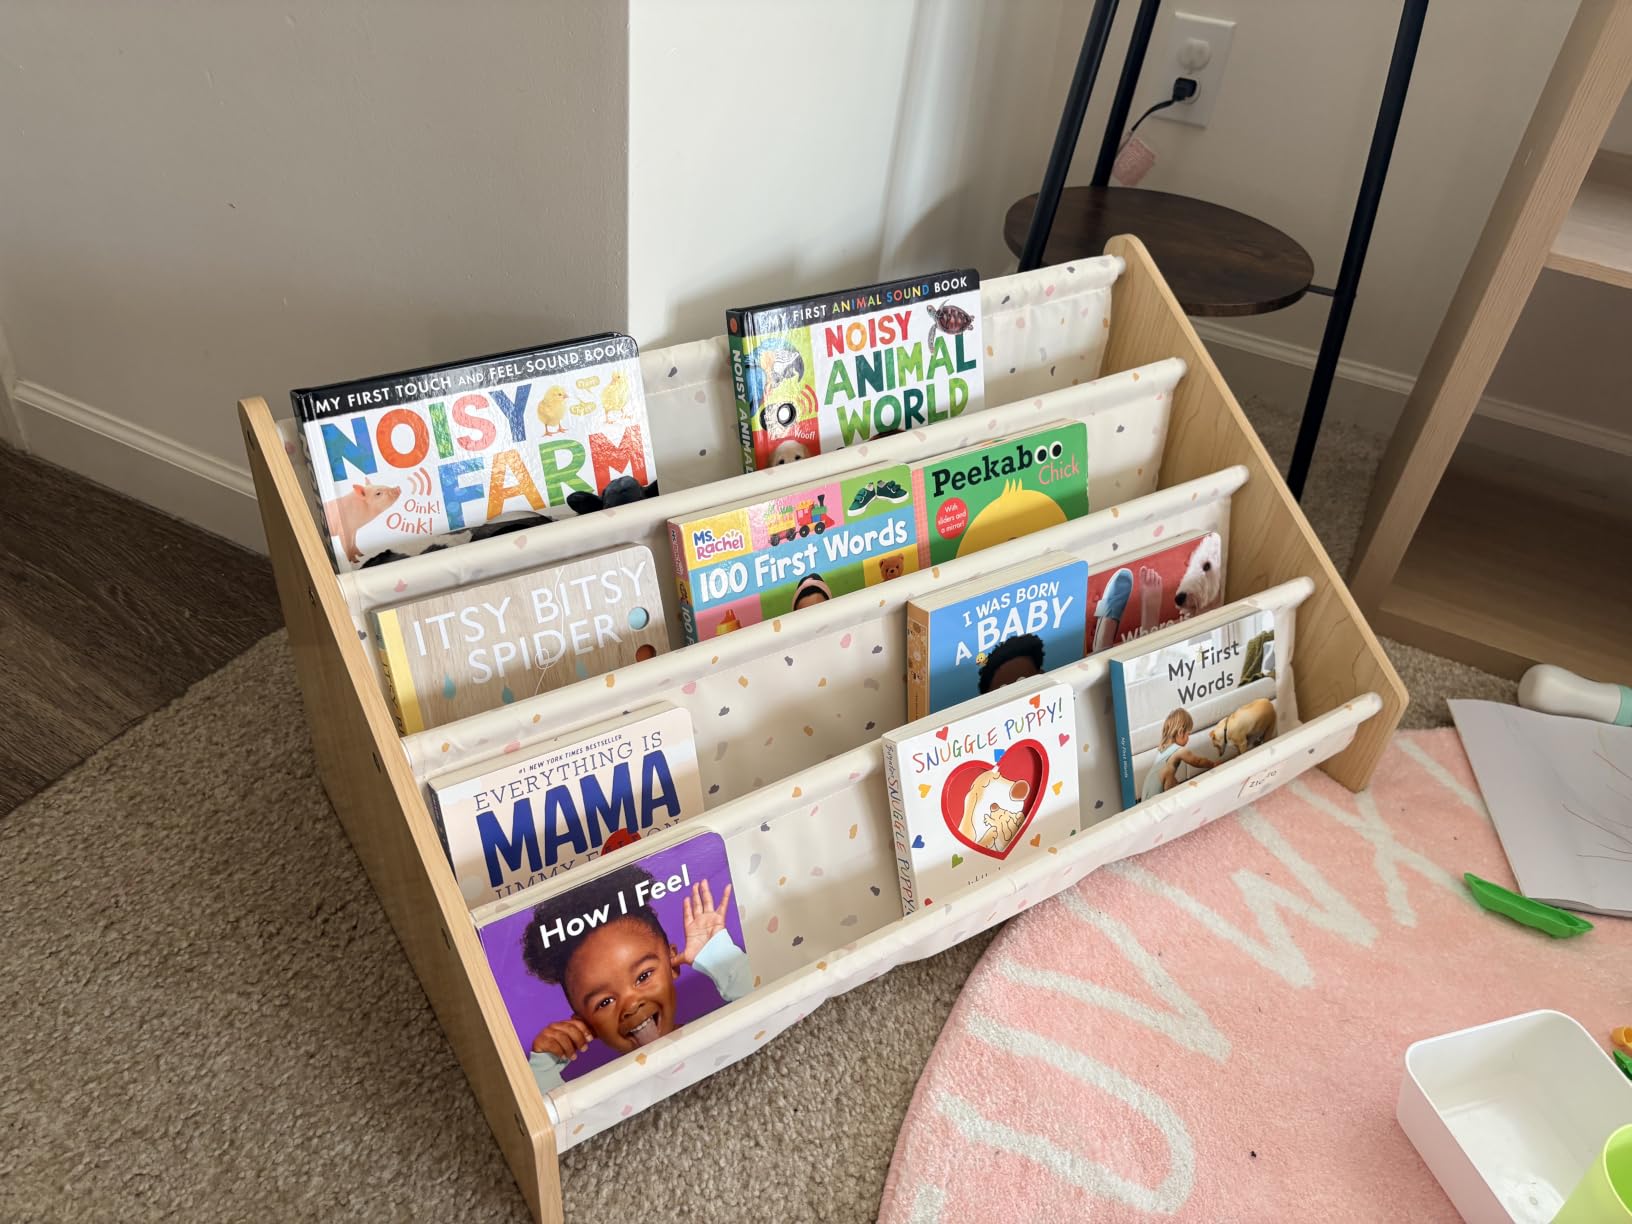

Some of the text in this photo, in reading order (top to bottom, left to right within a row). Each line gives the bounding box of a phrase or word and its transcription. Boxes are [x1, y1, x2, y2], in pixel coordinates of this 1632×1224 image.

[768, 276, 968, 326] MY FIRST ANIMAL SOUND BOOK
[824, 310, 912, 358] NOISY
[316, 343, 627, 414] MY FIRST TOUCH AND FEEL SOUND BOOK
[732, 349, 747, 402] NOISY
[824, 334, 977, 405] ANIMAL
[320, 383, 532, 482] NOISY
[836, 377, 969, 448] WORLD
[438, 424, 649, 531] FARM
[932, 440, 1063, 497] Peekaboo
[1039, 452, 1080, 485] Chick
[386, 511, 434, 536] Oink!
[404, 498, 441, 516] Oink!
[937, 511, 967, 525] sliders and
[944, 503, 958, 513] With
[693, 530, 715, 546] Ms.
[697, 534, 744, 560] Rachel
[700, 518, 908, 603] 100 First Words
[413, 560, 647, 657] ITSY BITSY
[682, 606, 693, 634] 100
[954, 595, 1074, 665] A BABY
[962, 581, 1060, 628] I WAS BORN
[468, 615, 623, 684] SPIDER
[1168, 640, 1240, 682] My First
[1178, 671, 1234, 704] Words
[529, 761, 544, 771] NEW
[546, 755, 563, 765] YORK
[565, 747, 583, 759] TIMES
[585, 734, 623, 751] BESTSELLER
[912, 697, 1063, 774] SNUGGLE PUPPY!
[473, 731, 663, 812] EVERYTHING IS
[476, 749, 681, 888] MAMA
[888, 778, 906, 853] SNUGGLE
[898, 857, 915, 912] PUPPY!
[539, 863, 691, 949] How I Feel
